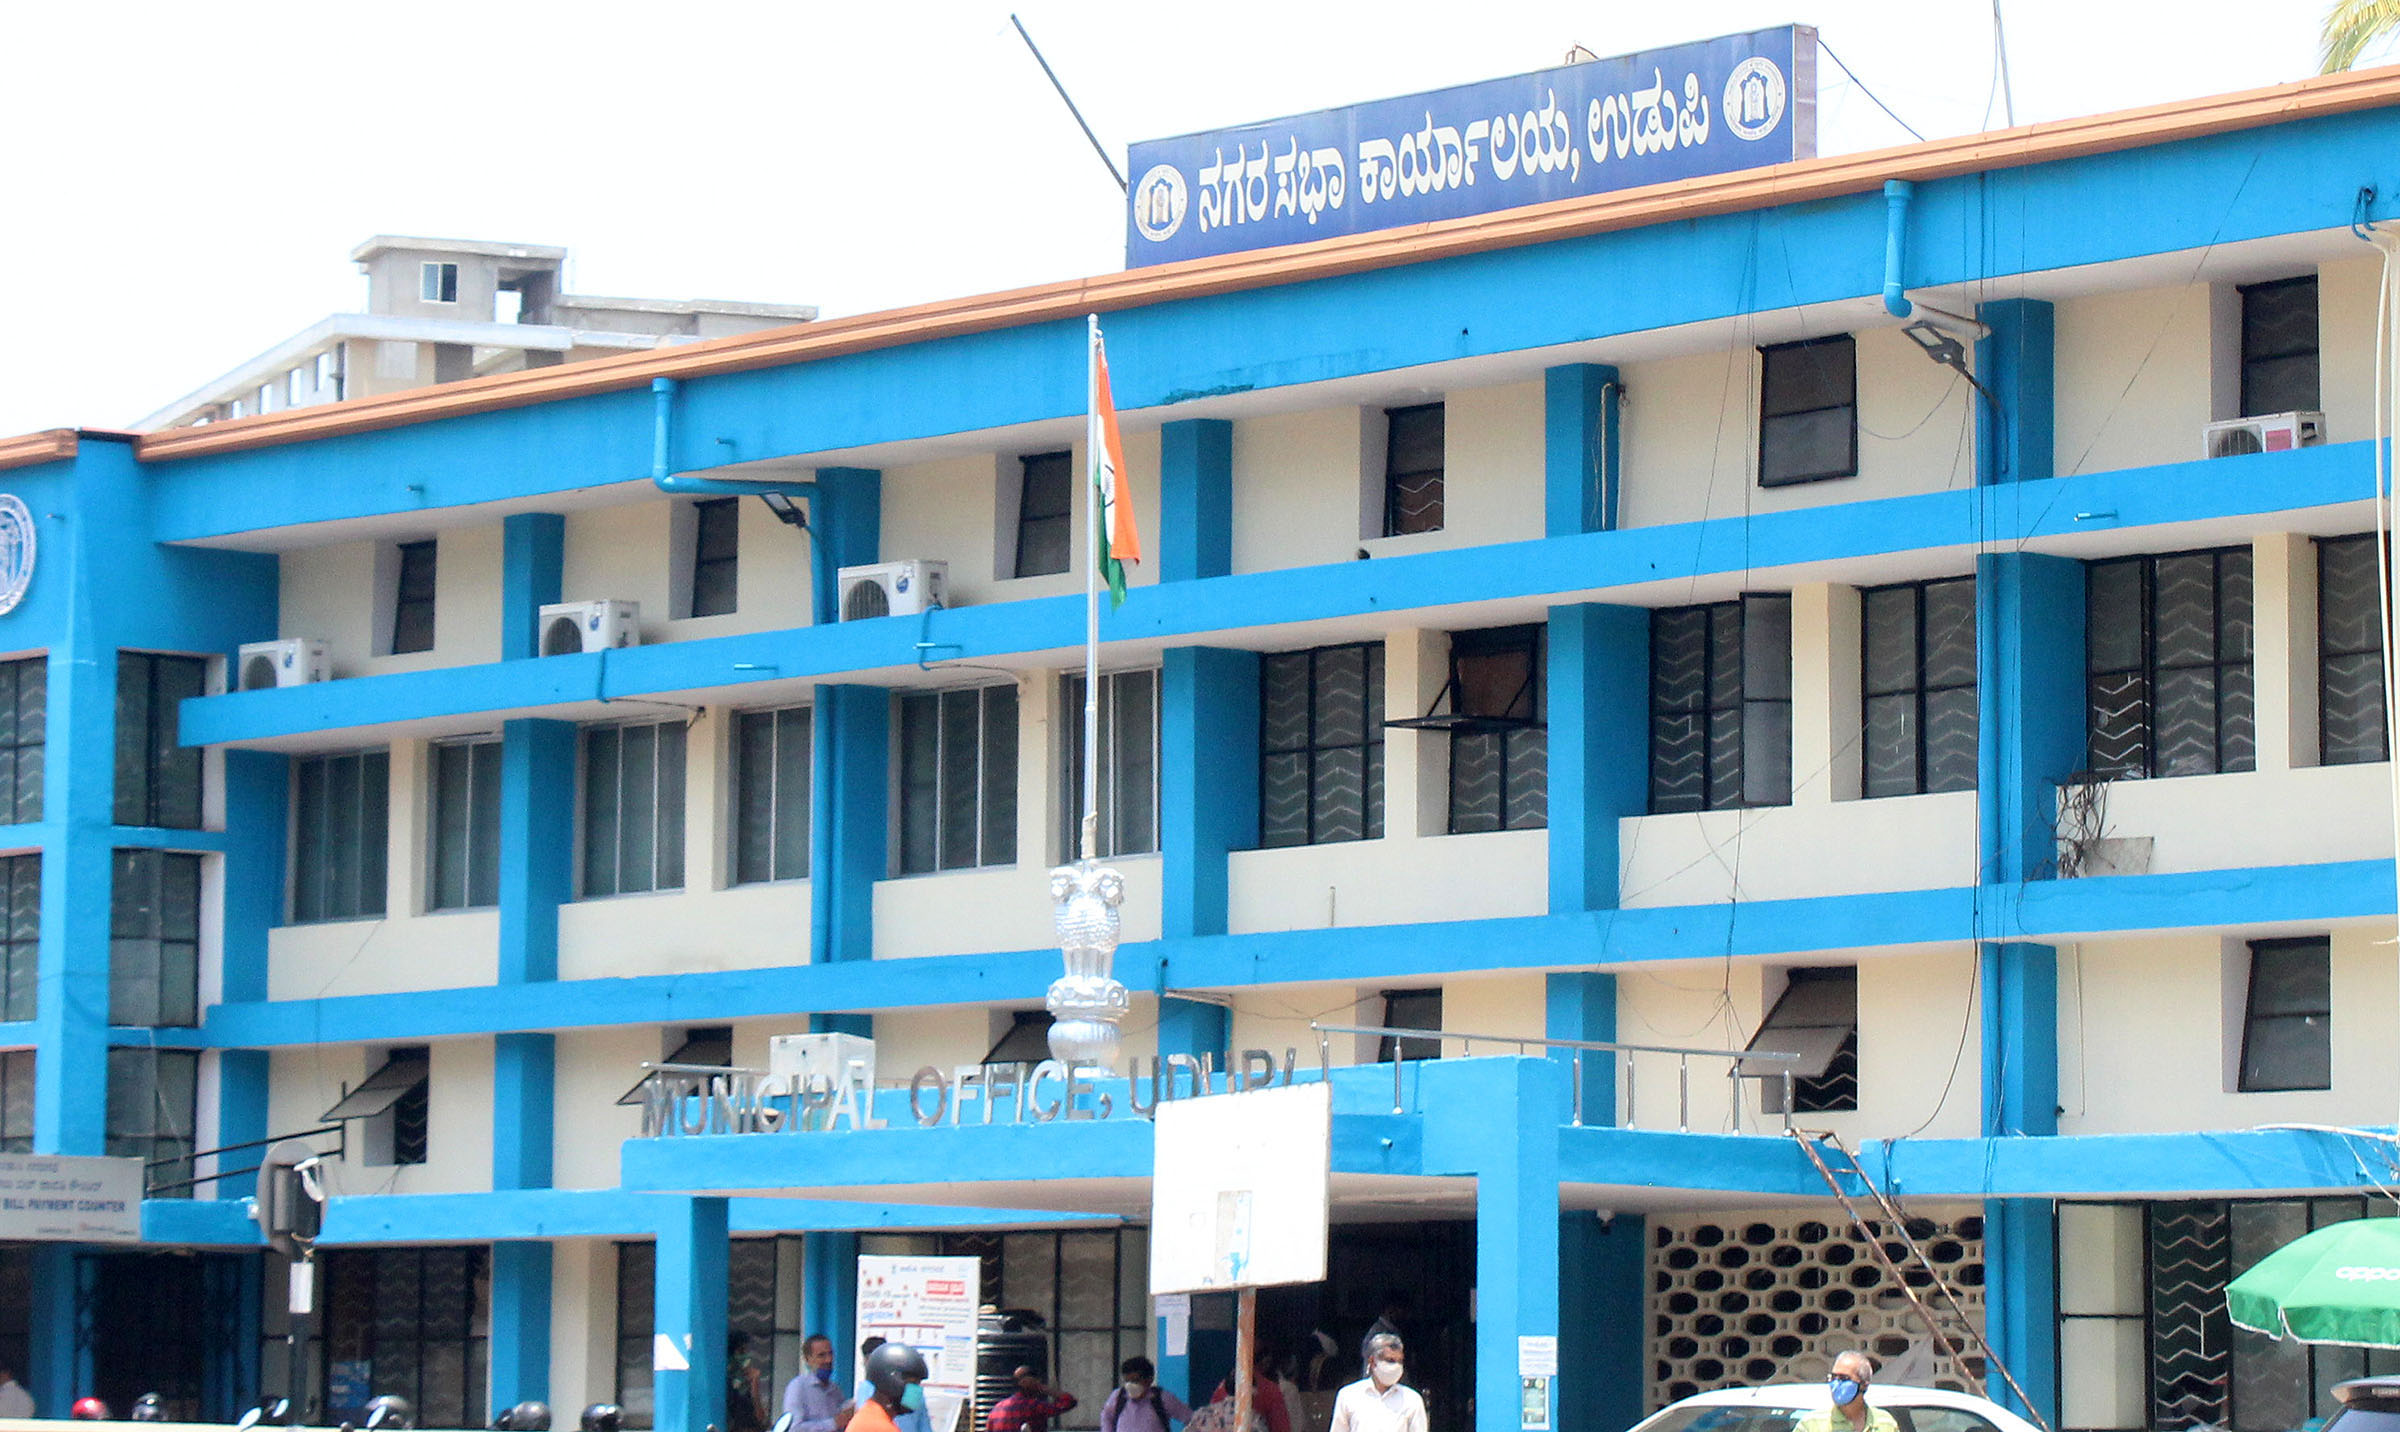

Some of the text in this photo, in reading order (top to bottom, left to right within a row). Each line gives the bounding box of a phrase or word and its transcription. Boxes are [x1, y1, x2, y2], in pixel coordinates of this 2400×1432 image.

[1199, 139, 1269, 233] ನಗರ
[1274, 135, 1346, 225] ಸಭಾ
[1359, 88, 1580, 204] ಕಾರ್ಯಾಲಯ,
[1588, 66, 1710, 163] ಉಡುಪಿ
[910, 1058, 1112, 1127] OFFICE,
[28, 1198, 74, 1211] PAYMENT
[77, 1199, 126, 1212] COUNTER
[2335, 1266, 2400, 1282] oppo
